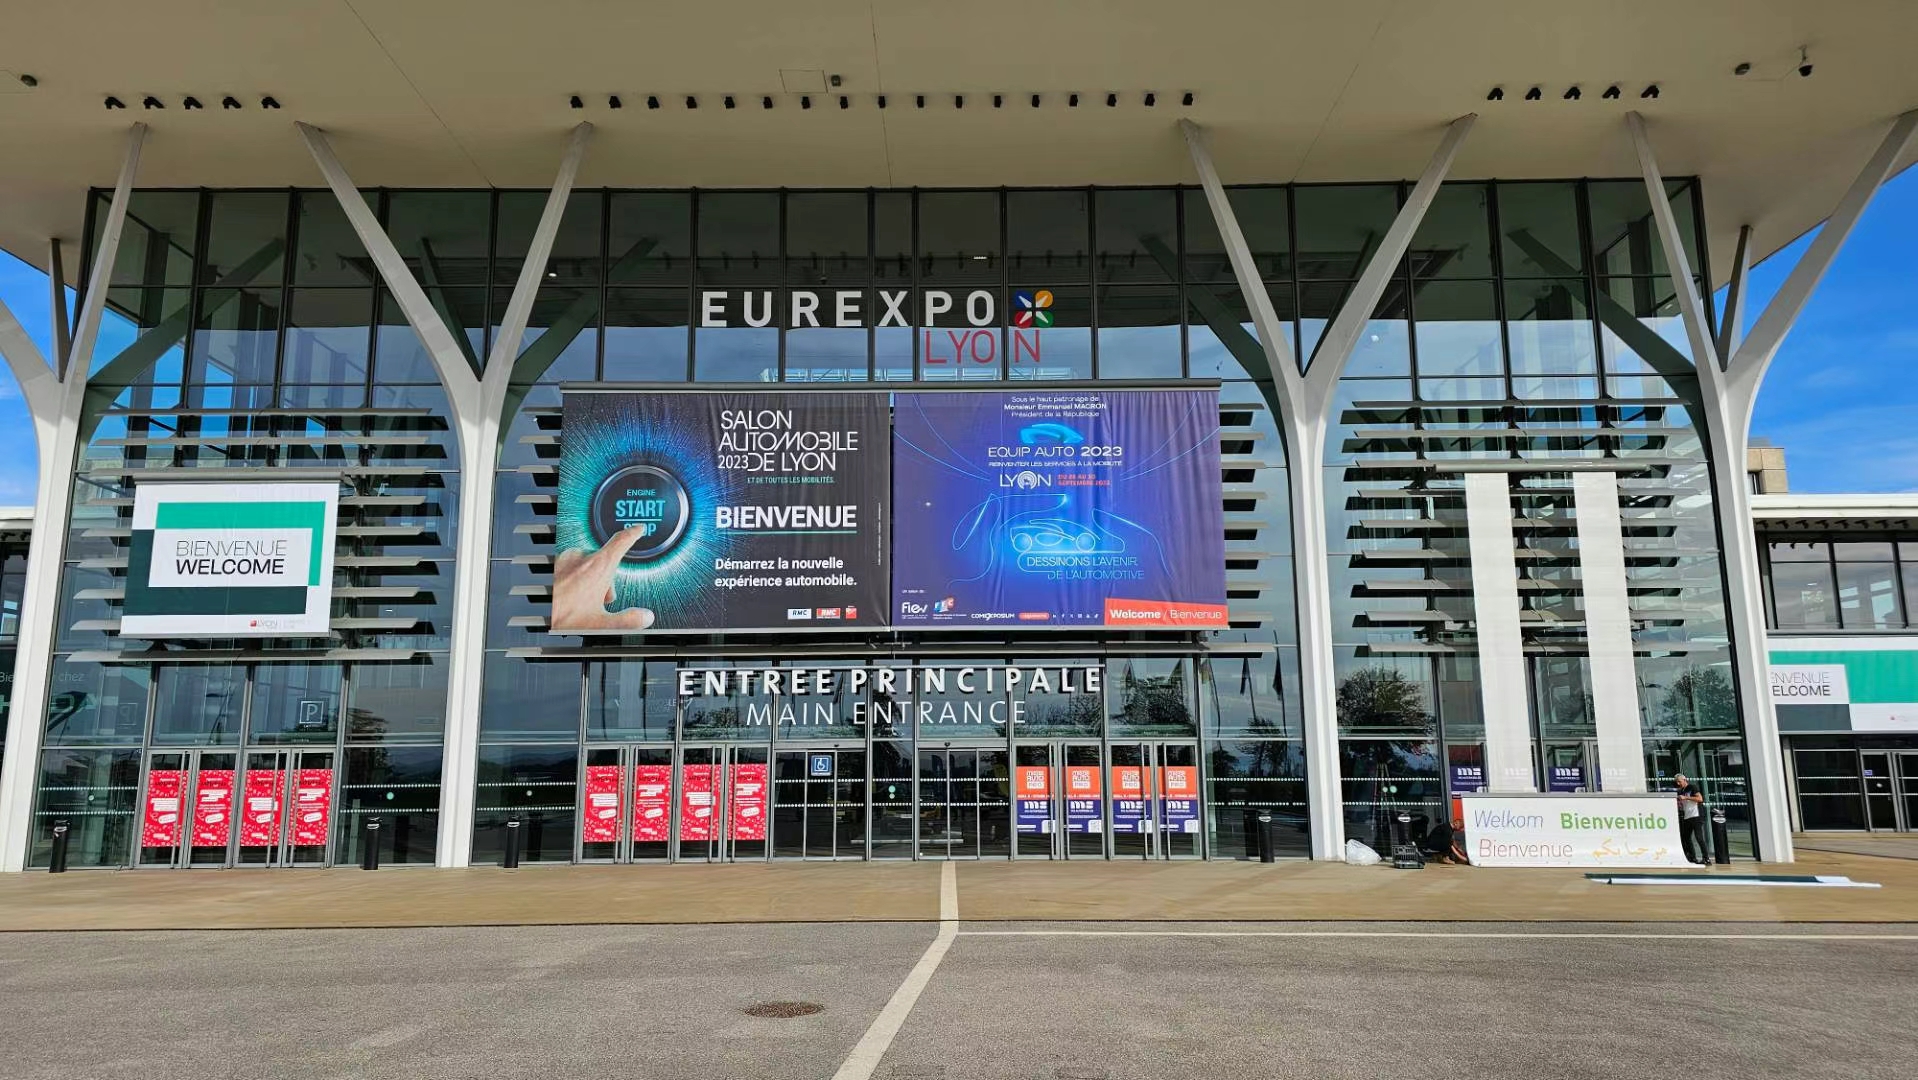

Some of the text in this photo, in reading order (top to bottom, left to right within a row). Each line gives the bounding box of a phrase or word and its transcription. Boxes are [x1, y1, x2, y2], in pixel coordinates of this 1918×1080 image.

[701, 290, 995, 327] EUREXPO
[924, 330, 1041, 364] LYON
[1053, 396, 1089, 404] patronage
[721, 410, 792, 430] SALON
[718, 431, 858, 451] AUTOMOBILE
[988, 446, 1123, 458] EQUIP AUTO 2023
[718, 452, 836, 471] 2023 DE LYON
[1000, 470, 1052, 489] LYON
[615, 500, 666, 517] START
[715, 505, 857, 529] BIENVENUE
[176, 540, 287, 556] BIENVENUE
[176, 559, 285, 575] WELCOME
[715, 557, 844, 570] Démarrez la nouvelle
[1027, 556, 1138, 567] DESSINONS L'AVENIR
[714, 574, 857, 589] expérience automobile.
[1047, 570, 1145, 580] DE L'AUTOMOTIVE
[1110, 609, 1161, 619] Welcome
[1170, 609, 1223, 619] Bienvenue
[680, 667, 1101, 695] ENTREE PRINCIPALE
[1772, 685, 1831, 696] ELCOME
[746, 701, 1027, 726] MAIN ENTRANCE
[1474, 810, 1667, 829] Welkom Bienvenido
[1479, 838, 1573, 857] Bienvenue
